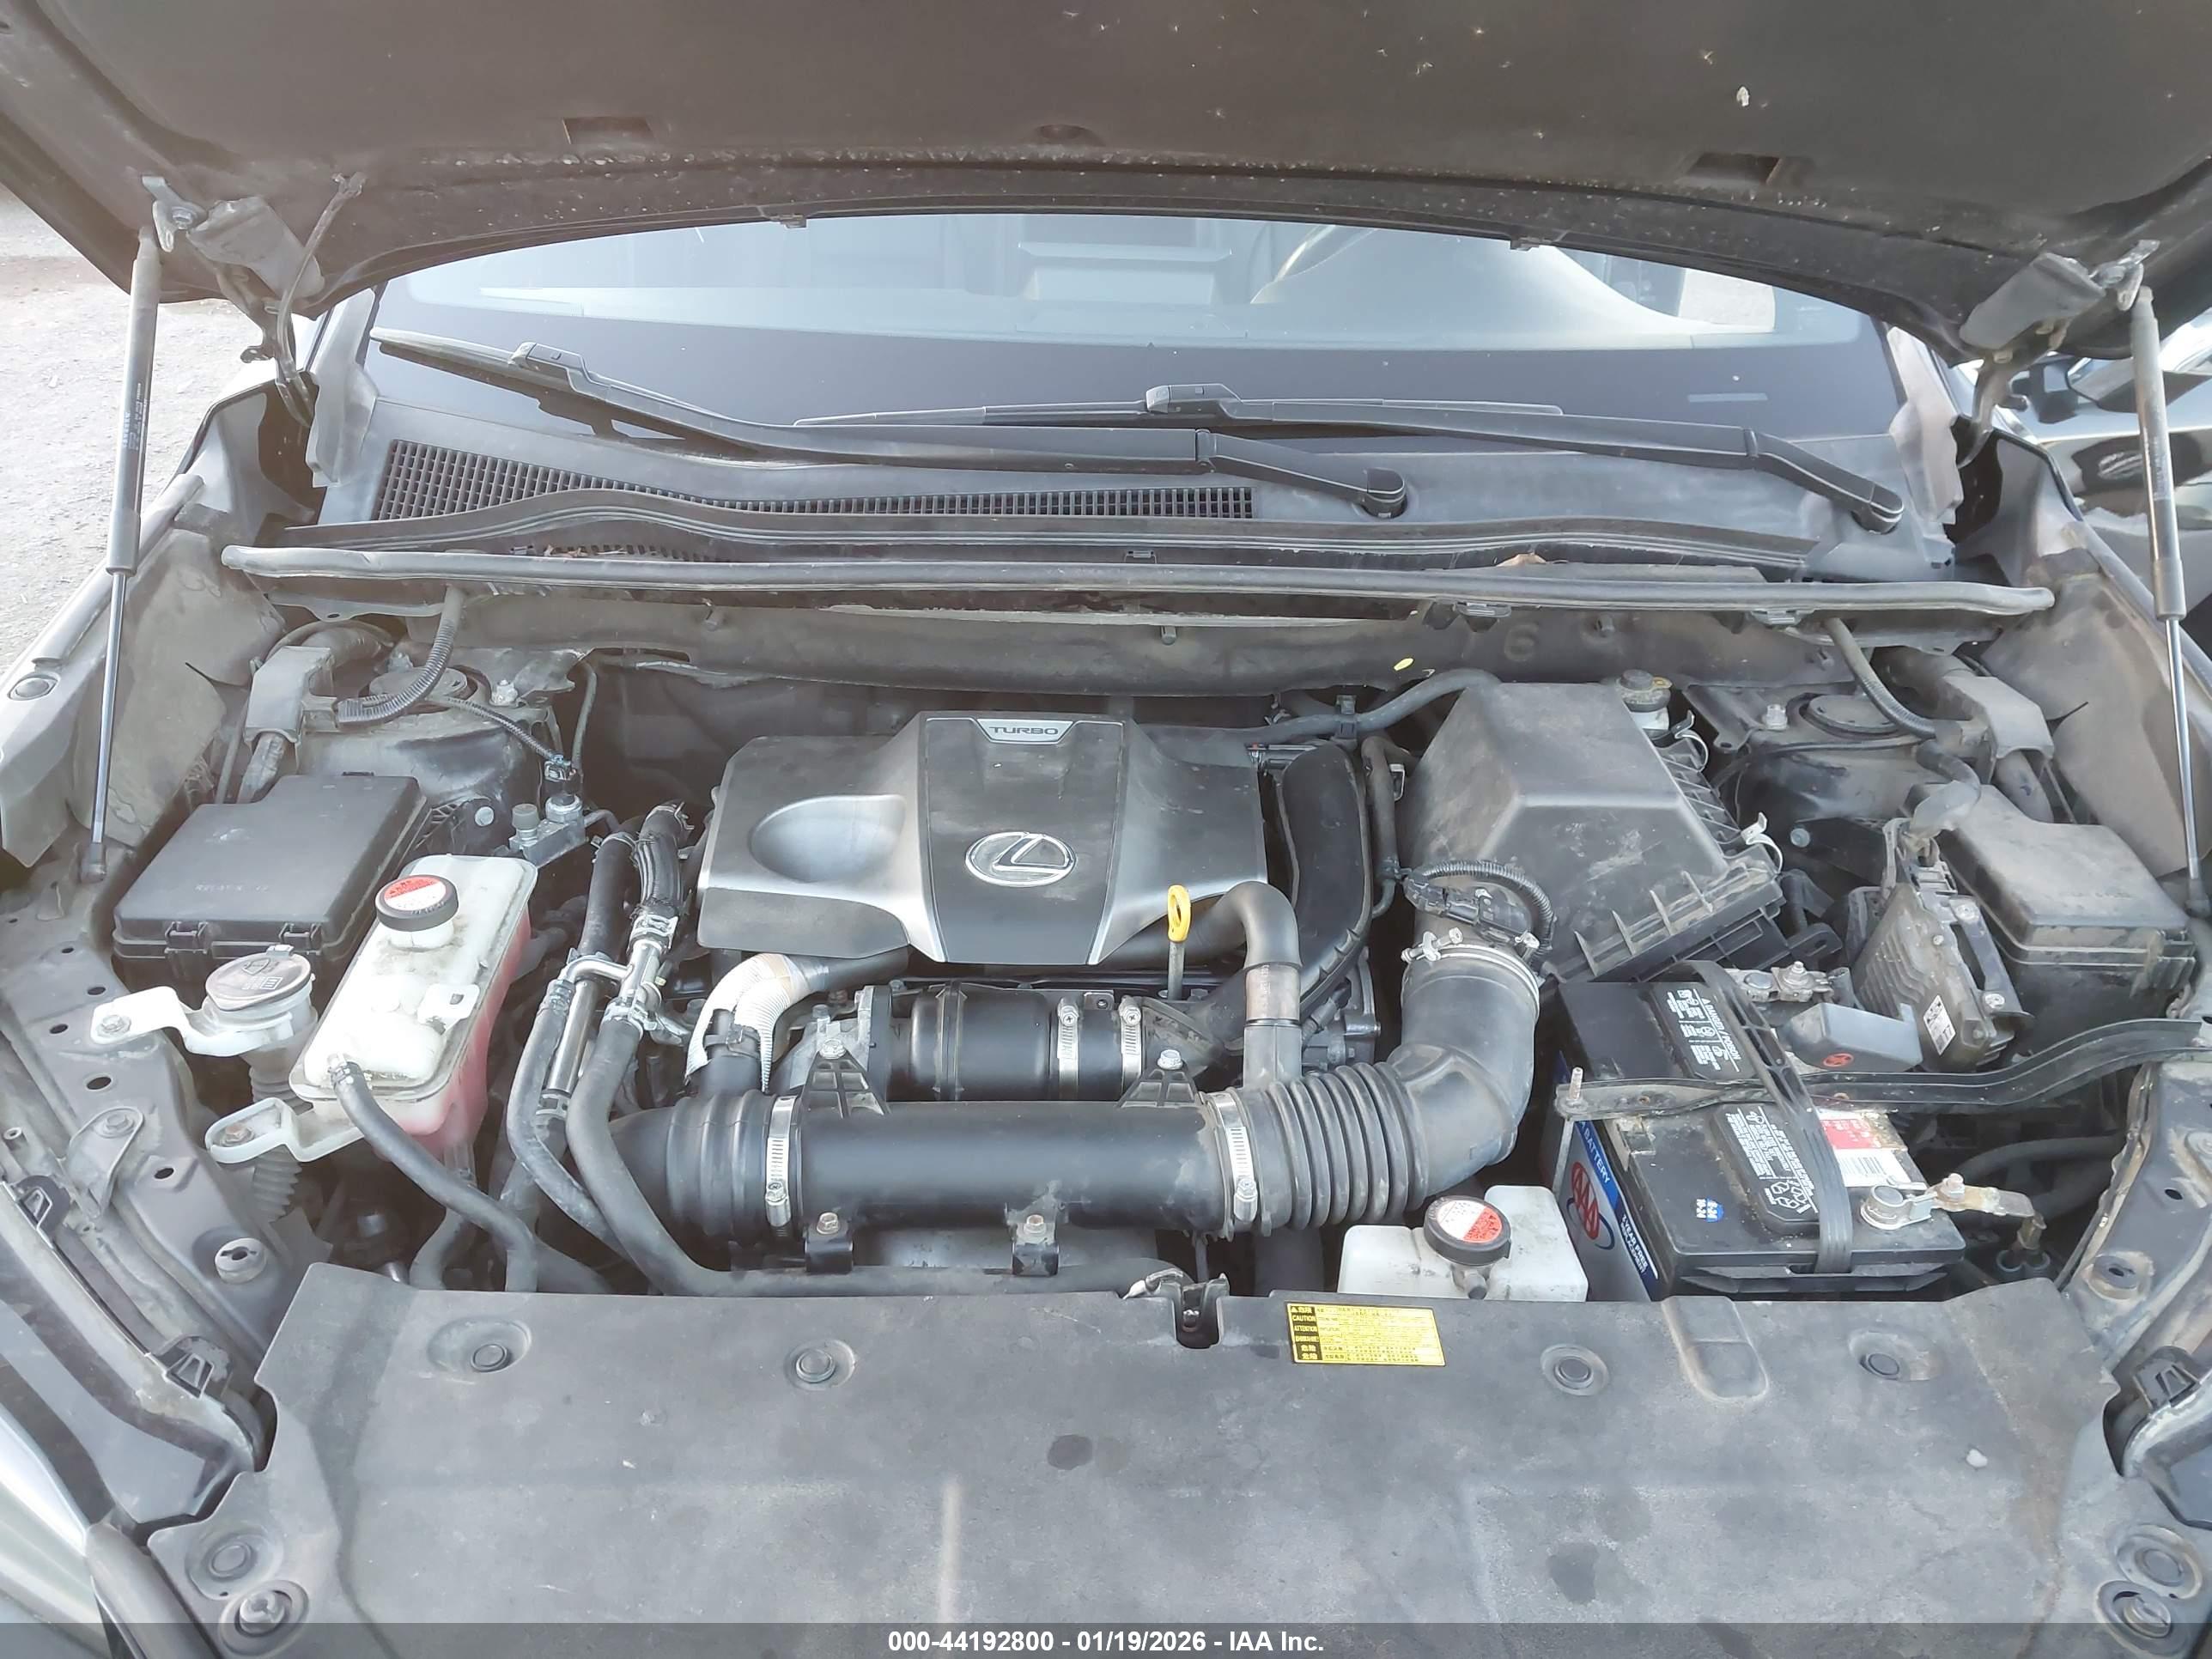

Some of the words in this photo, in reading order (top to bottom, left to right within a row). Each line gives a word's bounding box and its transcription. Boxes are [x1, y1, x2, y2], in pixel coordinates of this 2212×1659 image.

[988, 726, 1059, 735] TURBO
[1705, 1005, 1725, 1030] DANGER
[1721, 1036, 1742, 1060] POISON
[1584, 1127, 1611, 1183] BATTERY
[1571, 1162, 1601, 1240] AAA
[1625, 1219, 1637, 1246] YEAR
[1634, 1244, 1649, 1269] FREE
